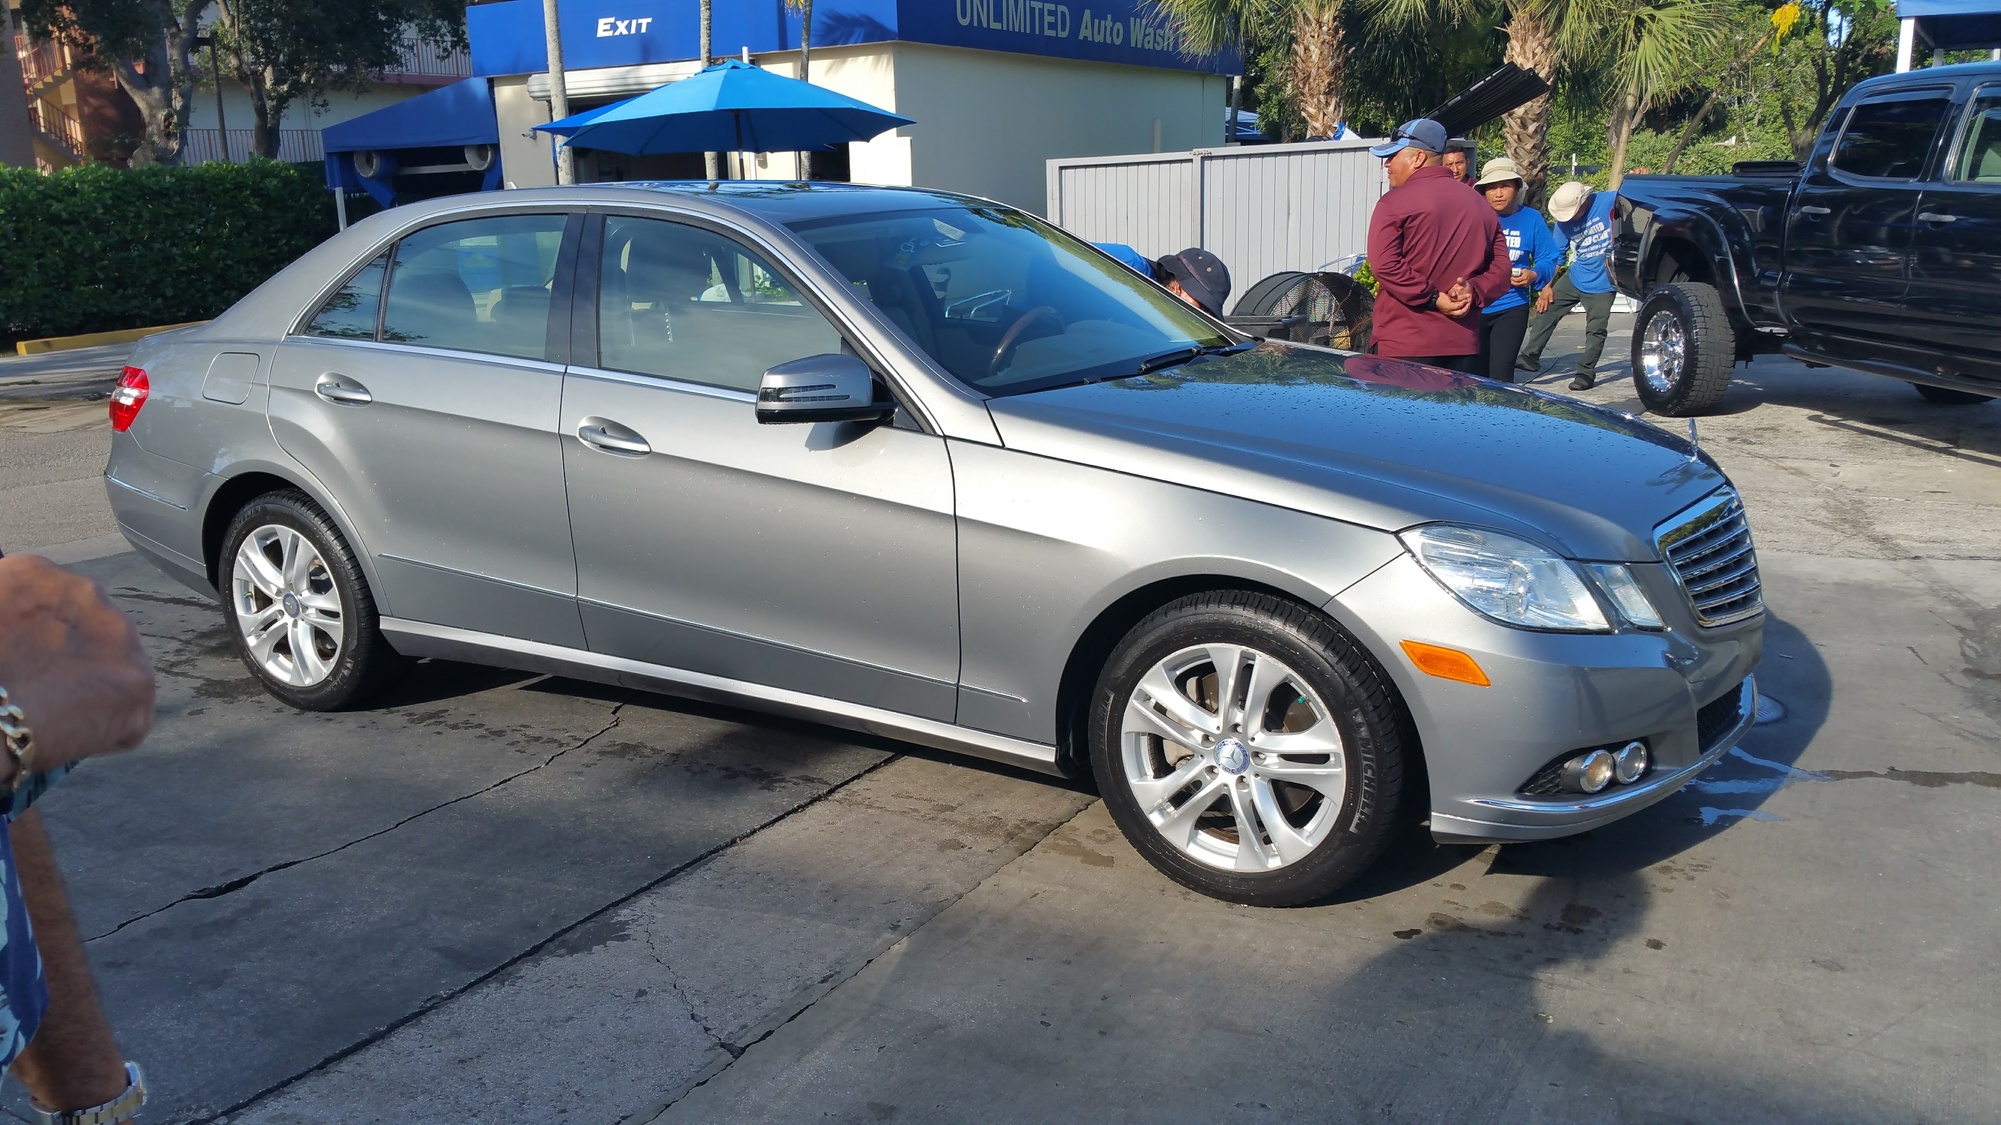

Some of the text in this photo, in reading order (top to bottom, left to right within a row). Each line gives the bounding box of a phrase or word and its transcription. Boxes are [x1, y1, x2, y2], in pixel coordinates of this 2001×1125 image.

[596, 17, 653, 38] EXIT
[956, 0, 1070, 38] UNLIMITED
[1078, 9, 1124, 46] Auto
[1130, 16, 1173, 51] Wash
